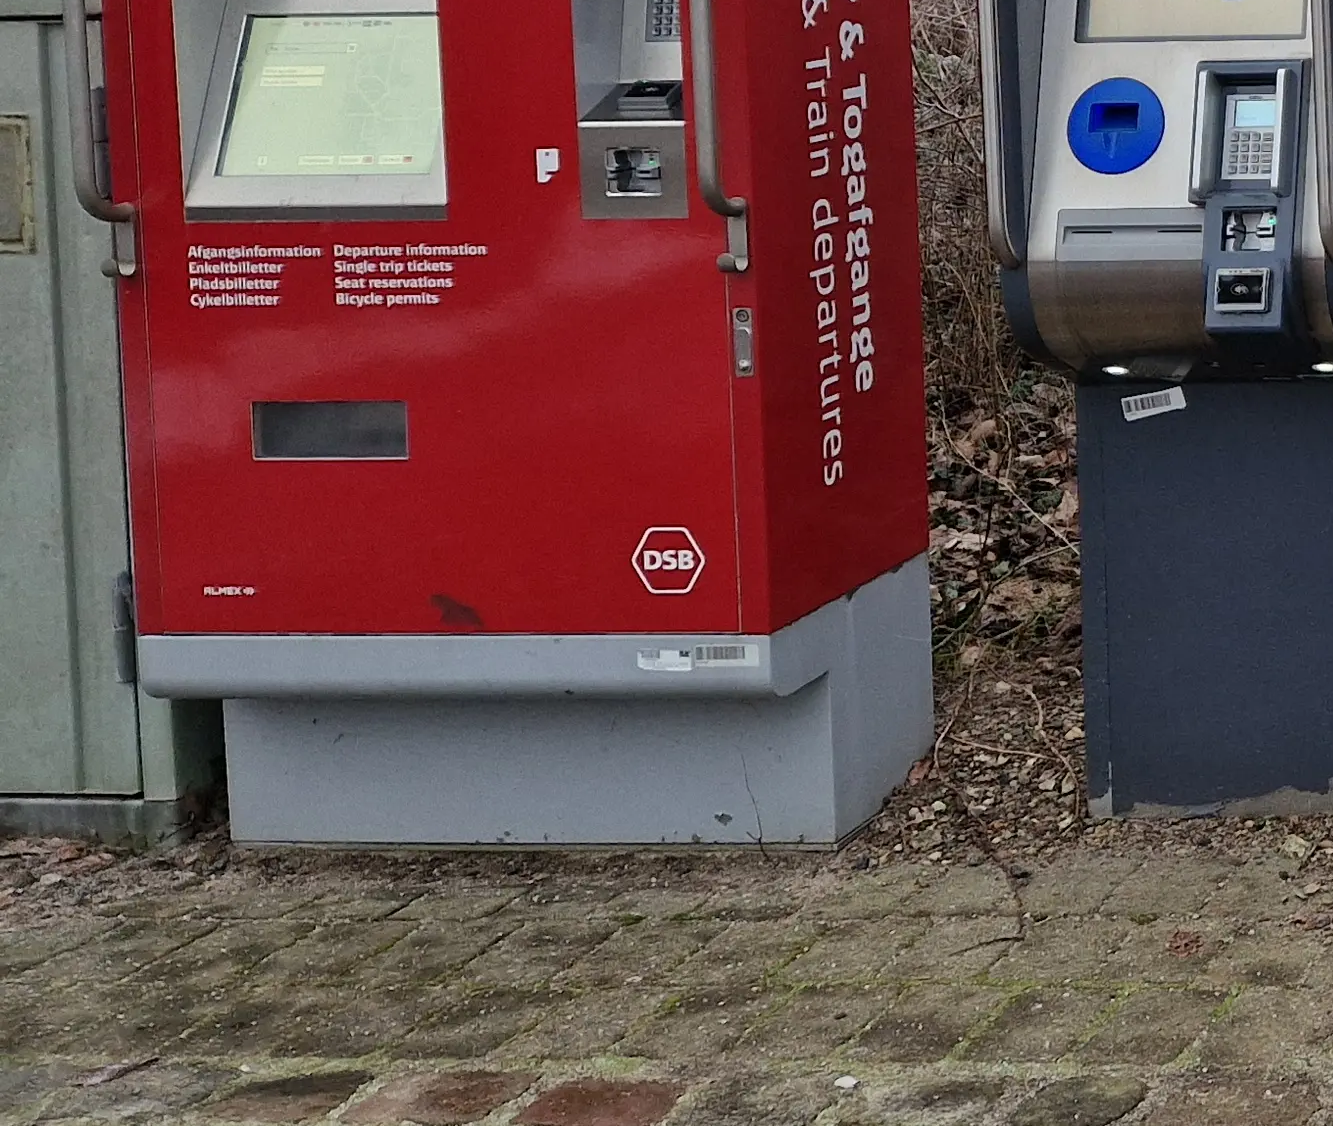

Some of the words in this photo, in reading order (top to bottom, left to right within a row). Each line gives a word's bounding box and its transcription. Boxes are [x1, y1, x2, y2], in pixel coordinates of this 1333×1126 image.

[838, 20, 866, 61] &
[802, 46, 834, 178] Train
[838, 73, 876, 393] Togafgange
[188, 245, 322, 260] Afgangsinformation
[333, 244, 403, 259] Departure
[405, 242, 488, 257] information
[188, 261, 285, 274] Enkeltbilletter
[333, 260, 377, 275] Single
[379, 260, 404, 275] trip
[406, 259, 454, 273] tickets
[189, 277, 280, 290] Pladsbilletter
[334, 276, 366, 289] Seat
[368, 276, 453, 289] reservations
[190, 293, 280, 308] Cykelbilletter
[335, 292, 385, 308] Bicycle
[386, 292, 440, 308] permits
[808, 198, 845, 488] departures
[643, 549, 695, 570] DSB
